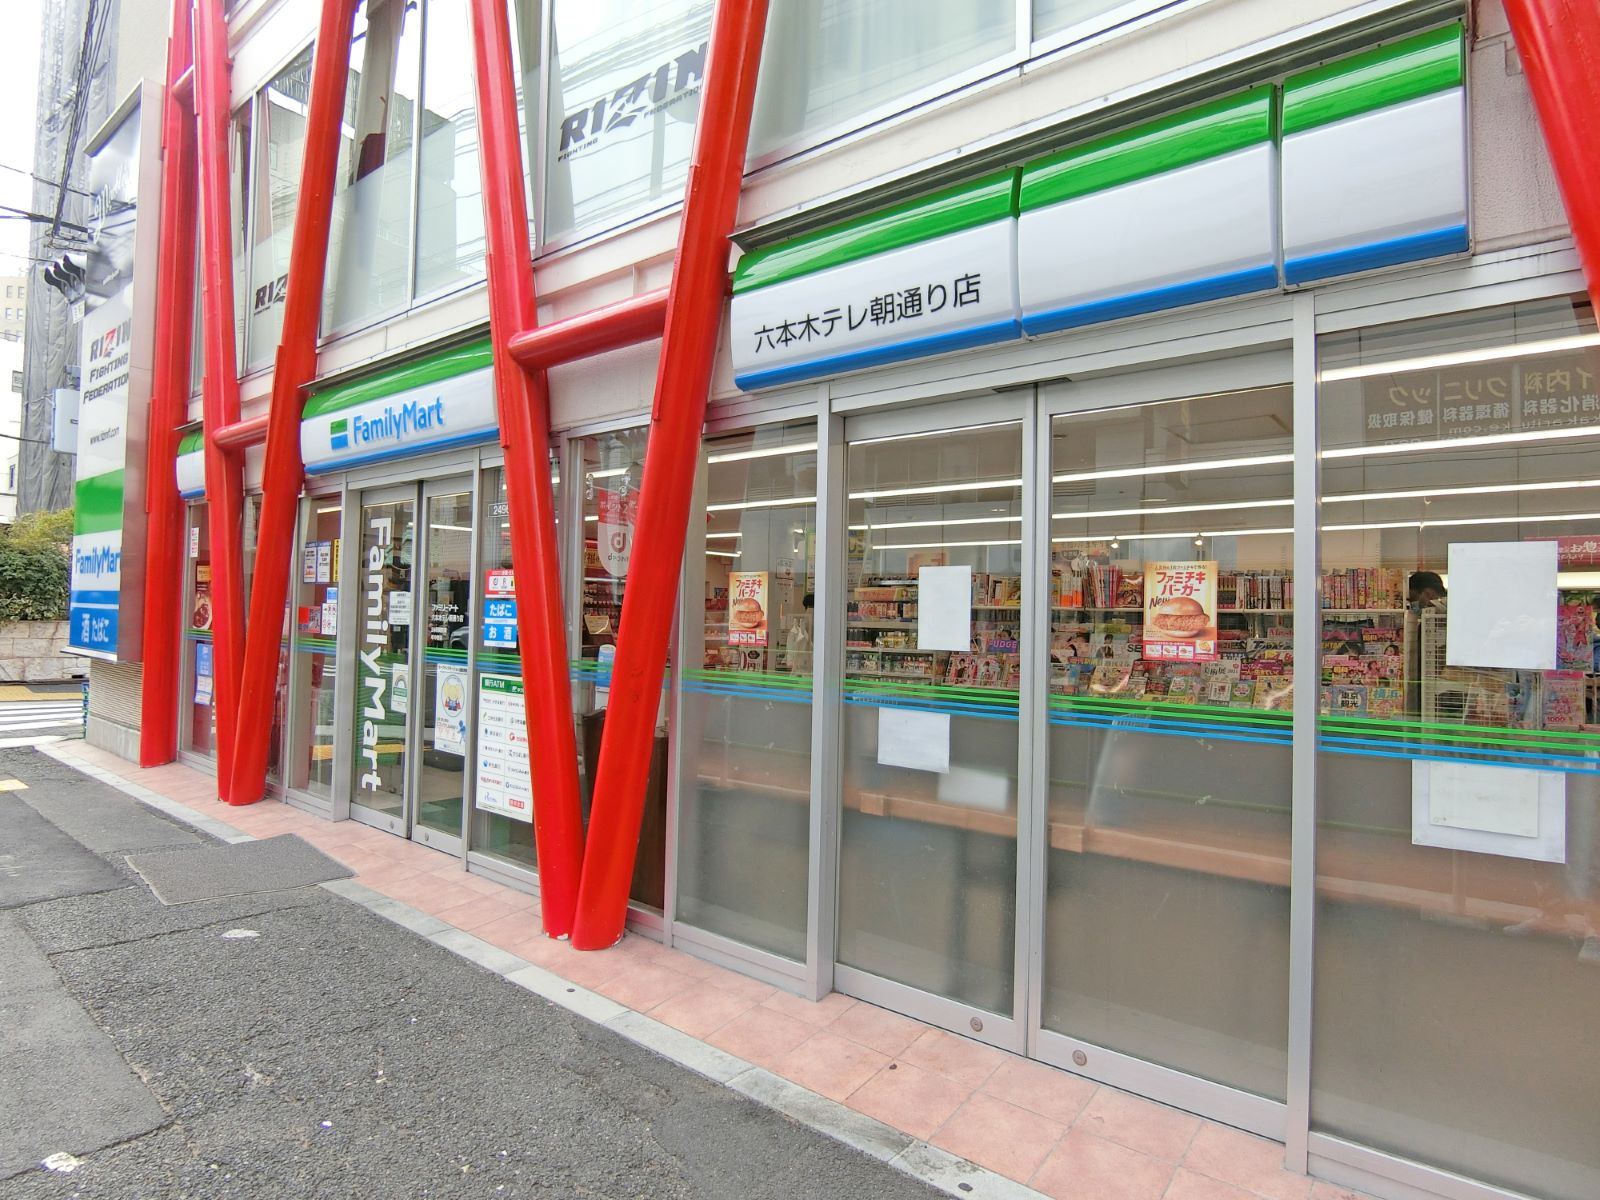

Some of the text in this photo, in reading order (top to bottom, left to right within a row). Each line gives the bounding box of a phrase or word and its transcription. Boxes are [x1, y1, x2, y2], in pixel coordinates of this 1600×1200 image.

[559, 41, 709, 151] RIZIN
[558, 85, 703, 162] FIGHTING FEDERATIO
[255, 273, 289, 310] RIZ
[754, 273, 981, 353] 六本木テレ朝通り店
[90, 318, 131, 362] RIZIN
[90, 353, 129, 382] FIGHTING
[353, 396, 444, 444] FamilyMart
[75, 545, 121, 578] FamilyMar
[1156, 571, 1206, 584] ファミチキ
[1161, 584, 1201, 596] バーガー
[82, 612, 109, 643] 酒 たばこ
[489, 603, 512, 617] たばこ
[360, 517, 392, 792] FamilyMart
